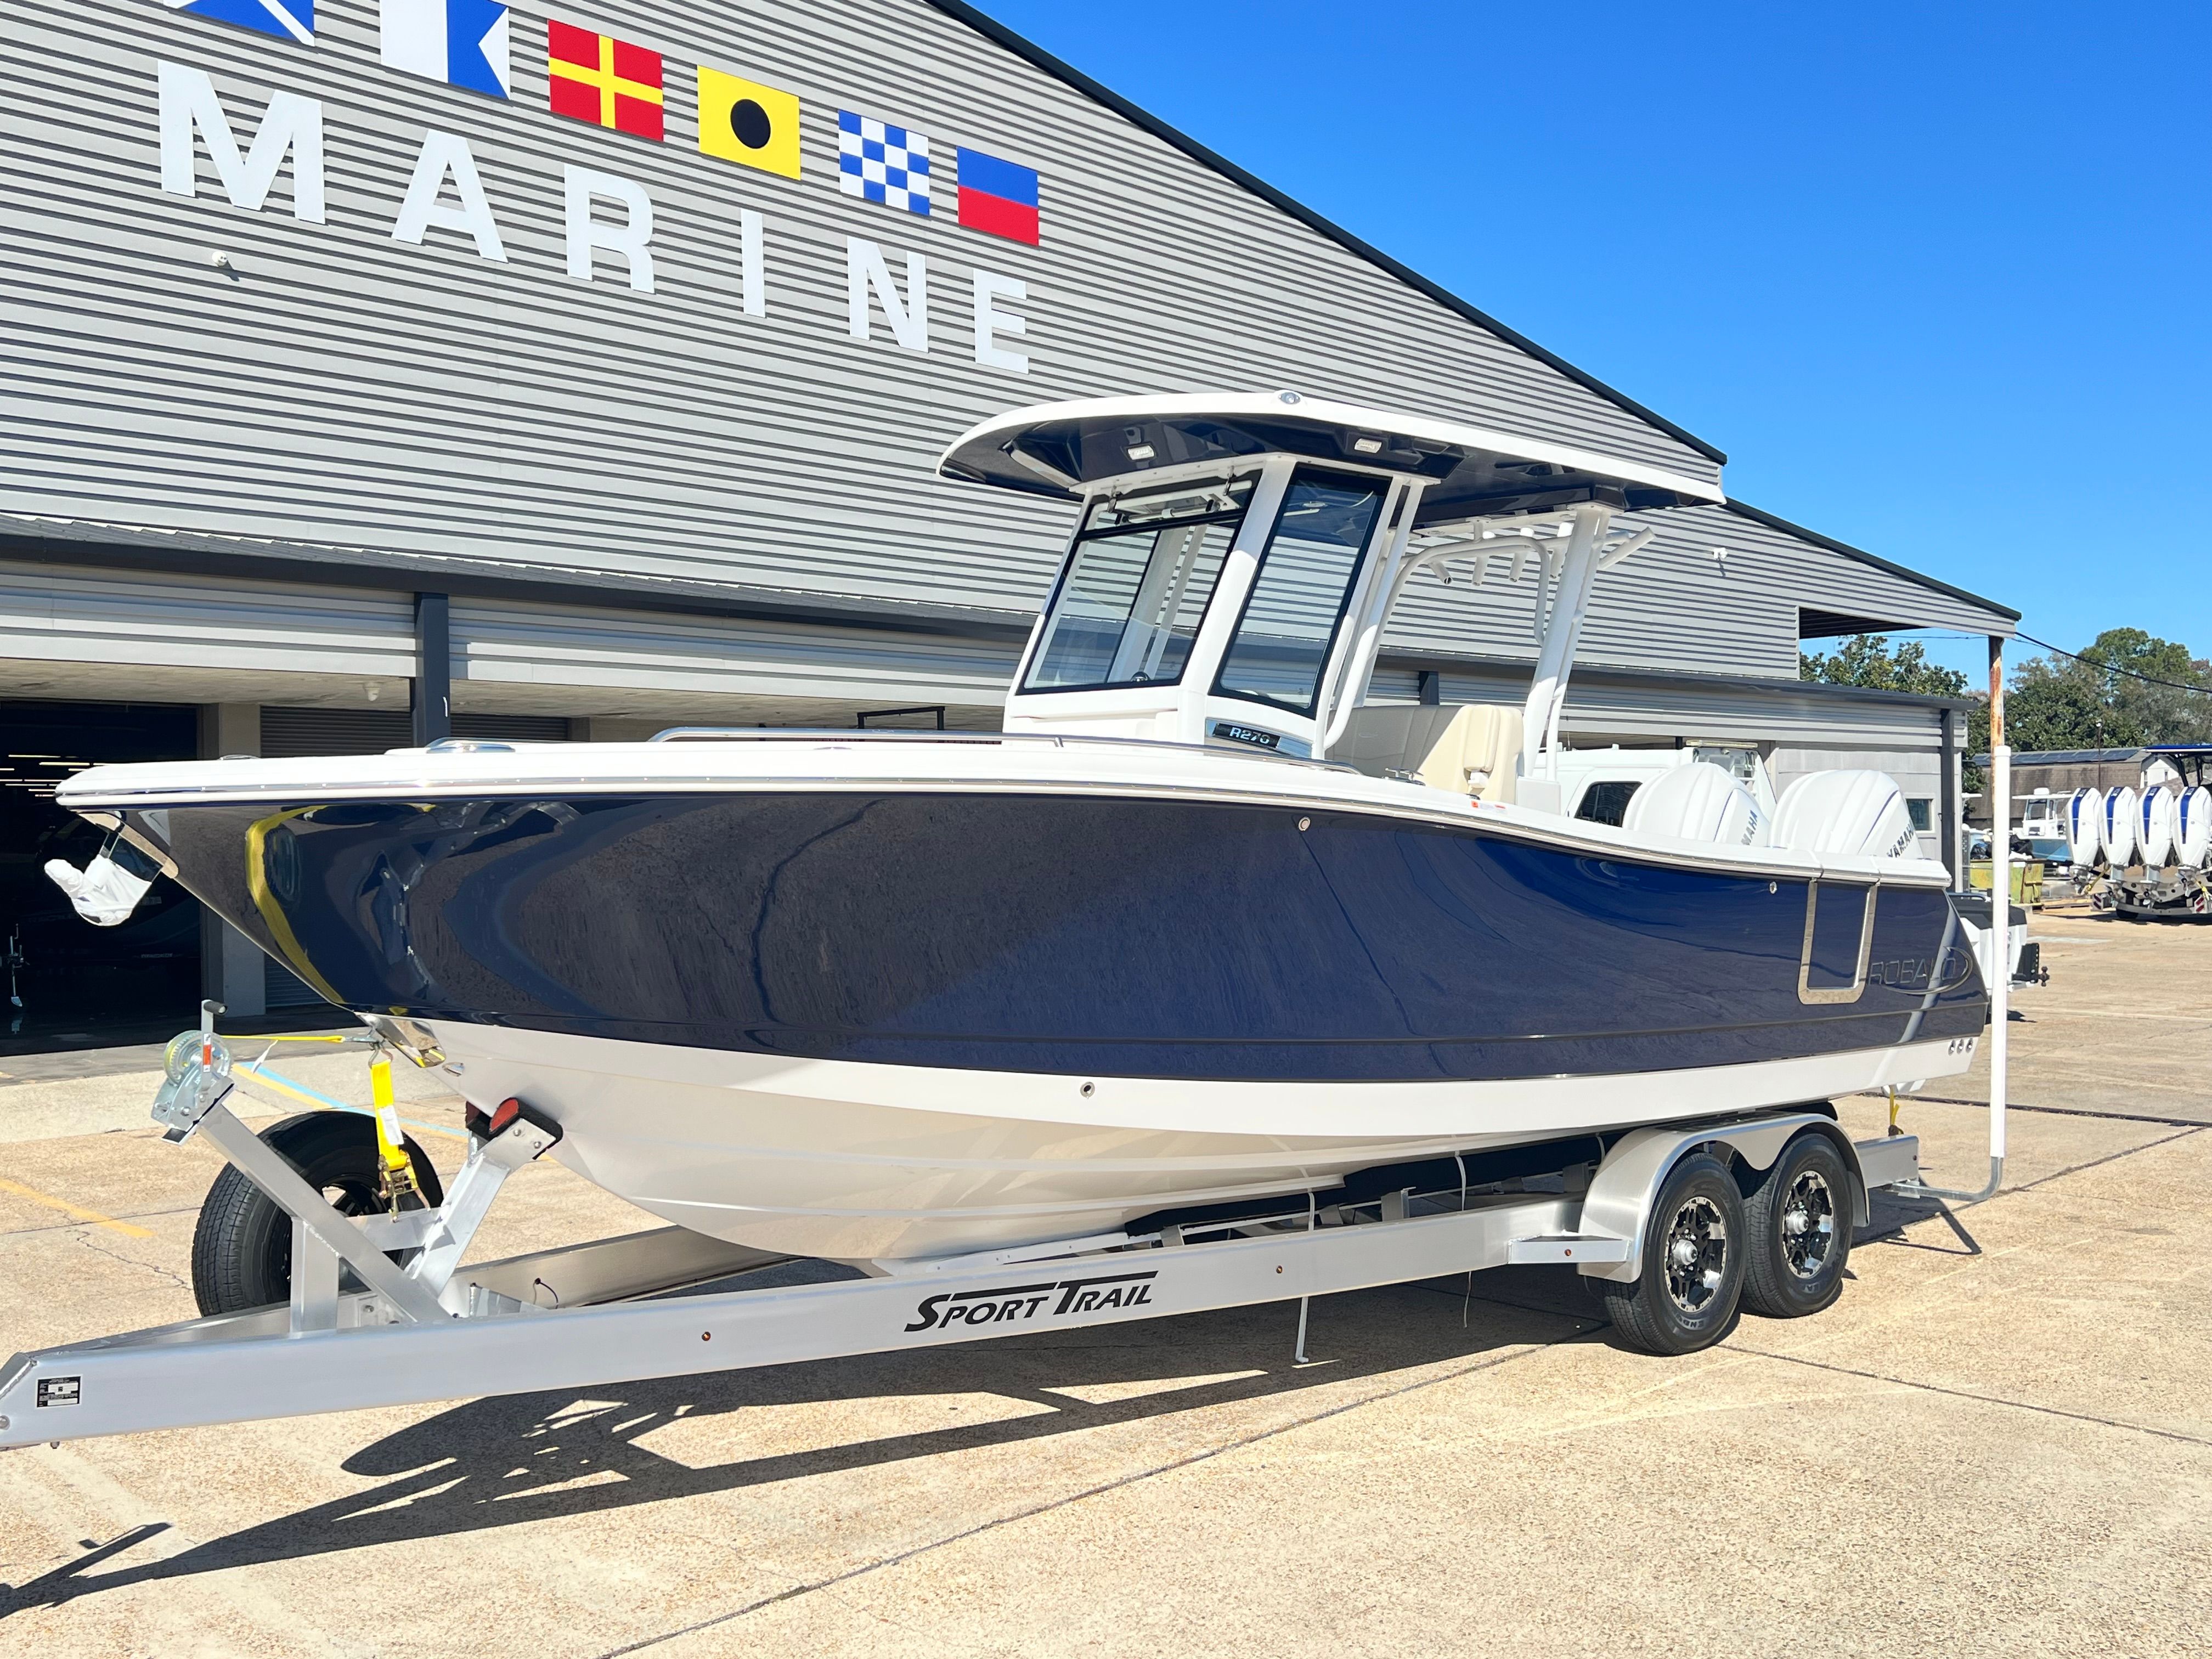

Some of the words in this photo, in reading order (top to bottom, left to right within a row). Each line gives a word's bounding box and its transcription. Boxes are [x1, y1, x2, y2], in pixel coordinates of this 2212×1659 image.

[157, 60, 1030, 374] MARINE
[1229, 727, 1270, 744] R270
[1741, 809, 1758, 845] MAHA
[1867, 956, 1959, 985] ROBALO
[904, 1282, 1058, 1331] SPORT
[1053, 1271, 1159, 1315] TRAIL
